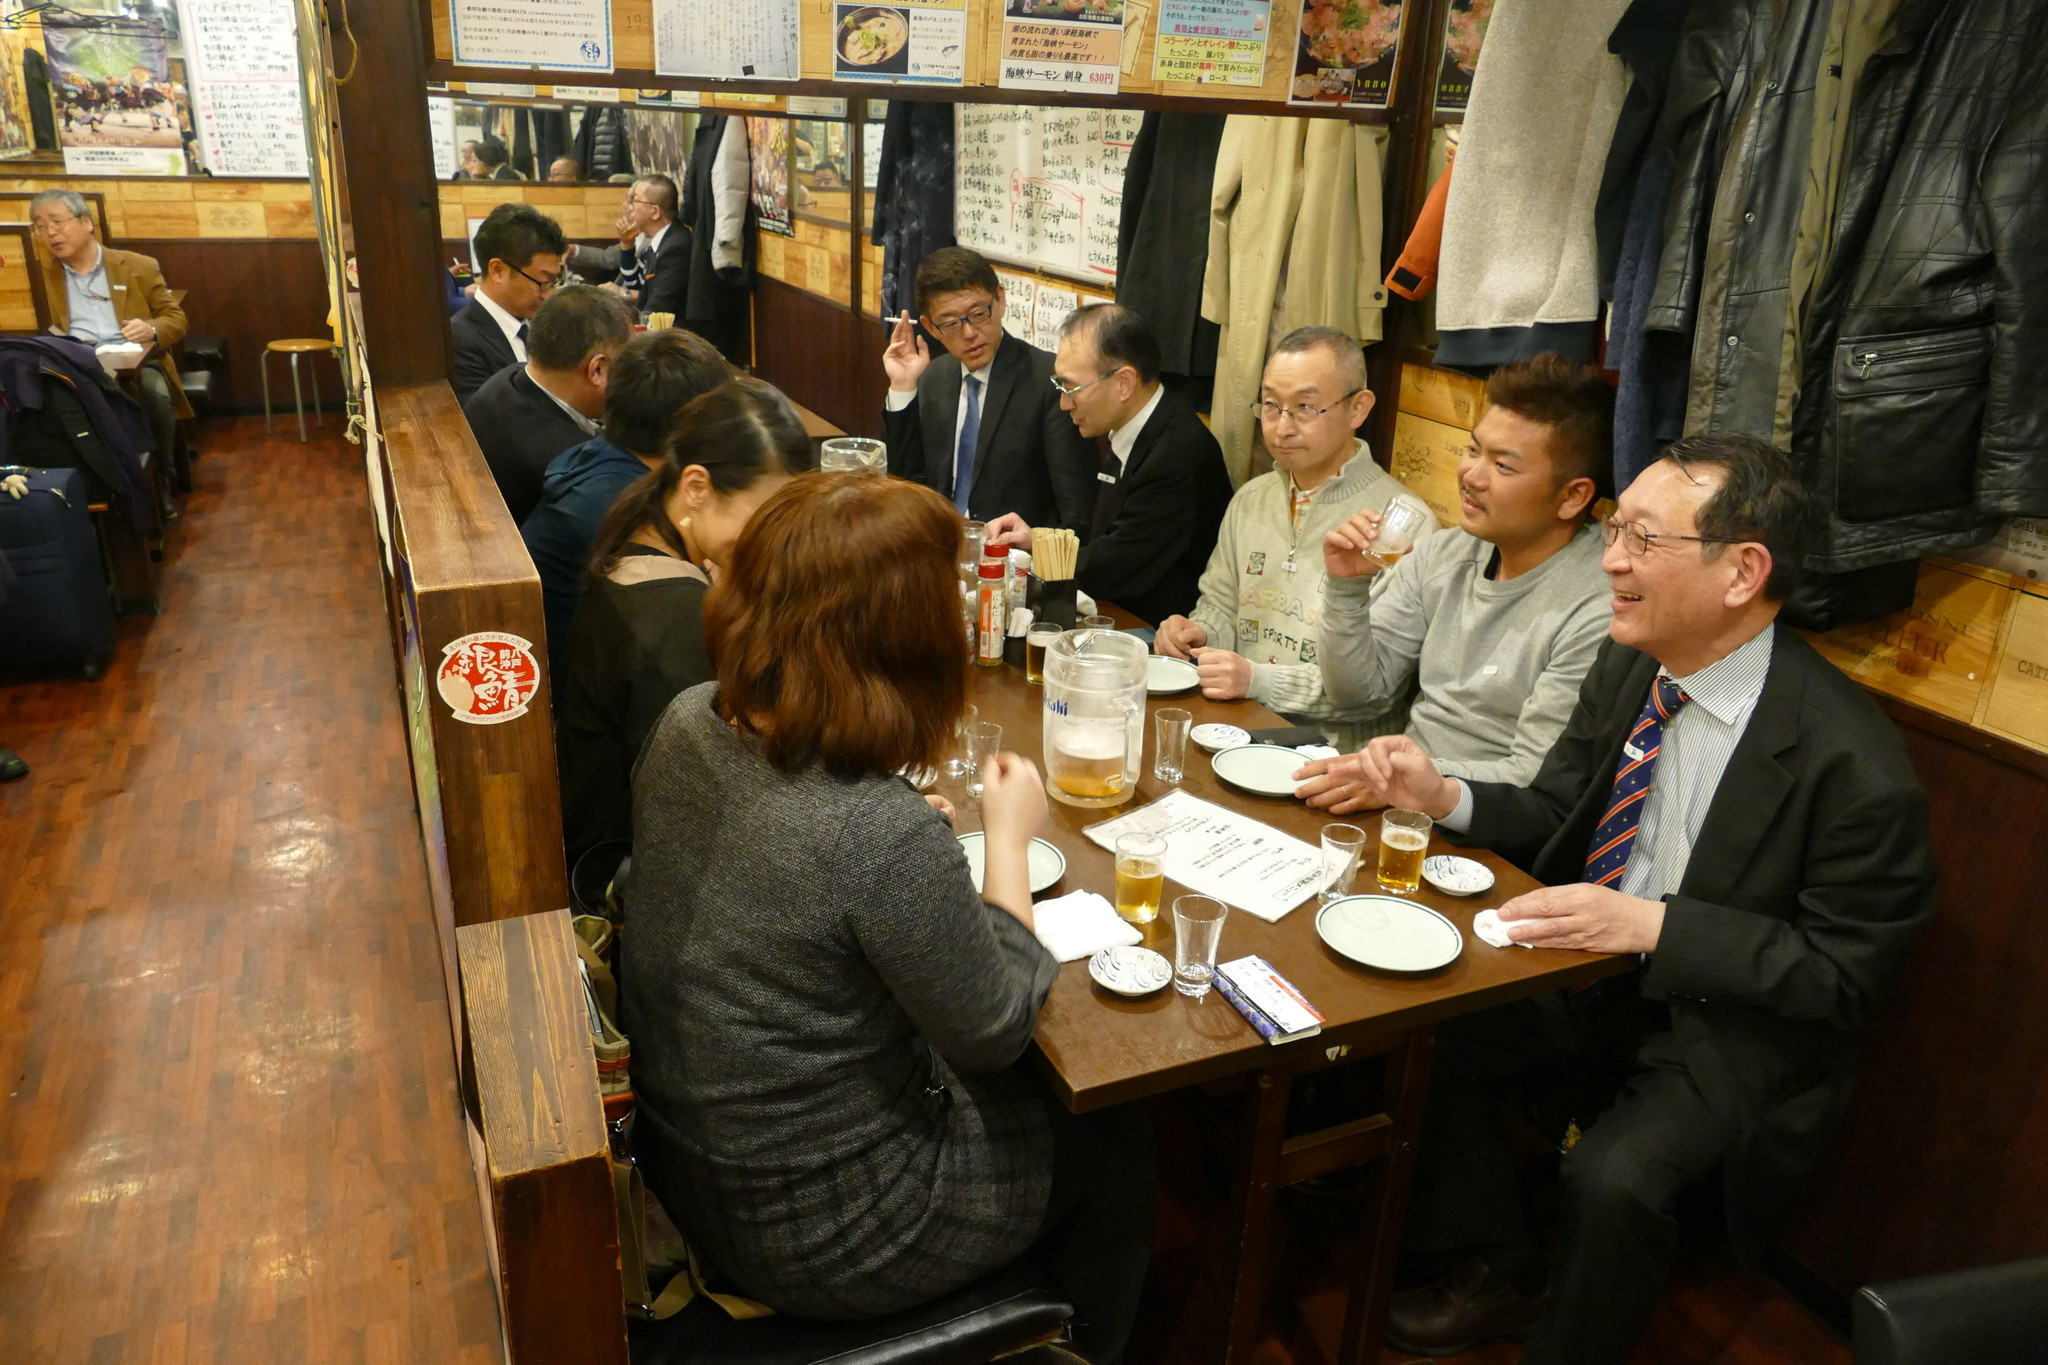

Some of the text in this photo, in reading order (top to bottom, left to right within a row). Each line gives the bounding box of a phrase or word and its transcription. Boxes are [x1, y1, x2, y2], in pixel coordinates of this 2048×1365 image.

[1011, 24, 1100, 39] 潮の流れの速い津軽海峡で
[1010, 37, 1089, 50] 育まれた「海峡サーモン」
[1163, 36, 1262, 51] コラーゲンとオレイン酸たっぷり
[1169, 48, 1200, 58] たっこぶた
[1205, 51, 1225, 60] 豚バラ
[1160, 60, 1260, 74] 赤身と脂肪が霜降りで旨みたっぷり
[1005, 66, 1114, 84] 海峡サーモン 刺身 630円
[1166, 71, 1196, 81] たっこぶた
[1208, 74, 1228, 82] ロース
